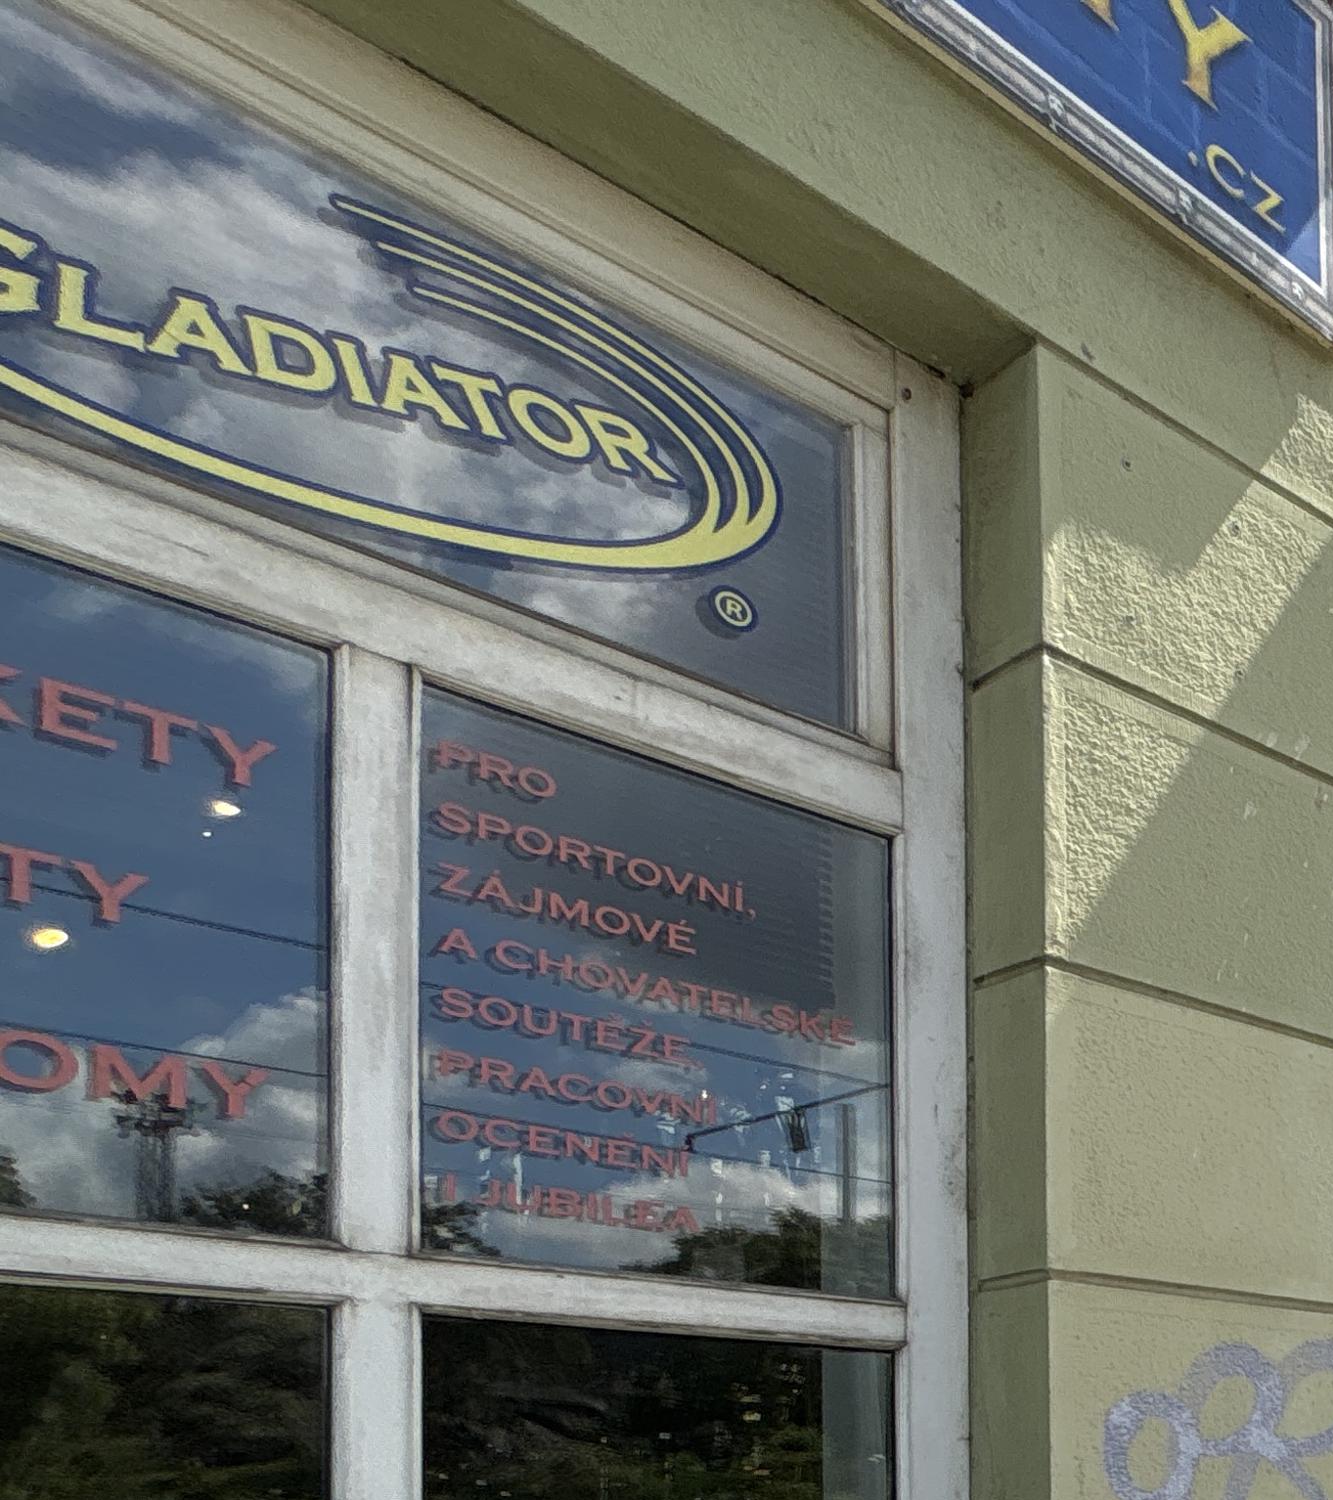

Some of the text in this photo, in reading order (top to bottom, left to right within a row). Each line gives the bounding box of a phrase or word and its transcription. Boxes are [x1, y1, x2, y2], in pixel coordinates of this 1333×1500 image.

[434, 738, 557, 799] PRO
[434, 801, 757, 919] SPORTOVNÍ,
[437, 862, 698, 955] ZÁJMOVÉ
[438, 928, 857, 1047] A CHOVATELSKÉ
[436, 1050, 717, 1126] PRACOVNÍ
[436, 1111, 690, 1178] OCENĚNÍ
[478, 1178, 701, 1233] JUBILEA
